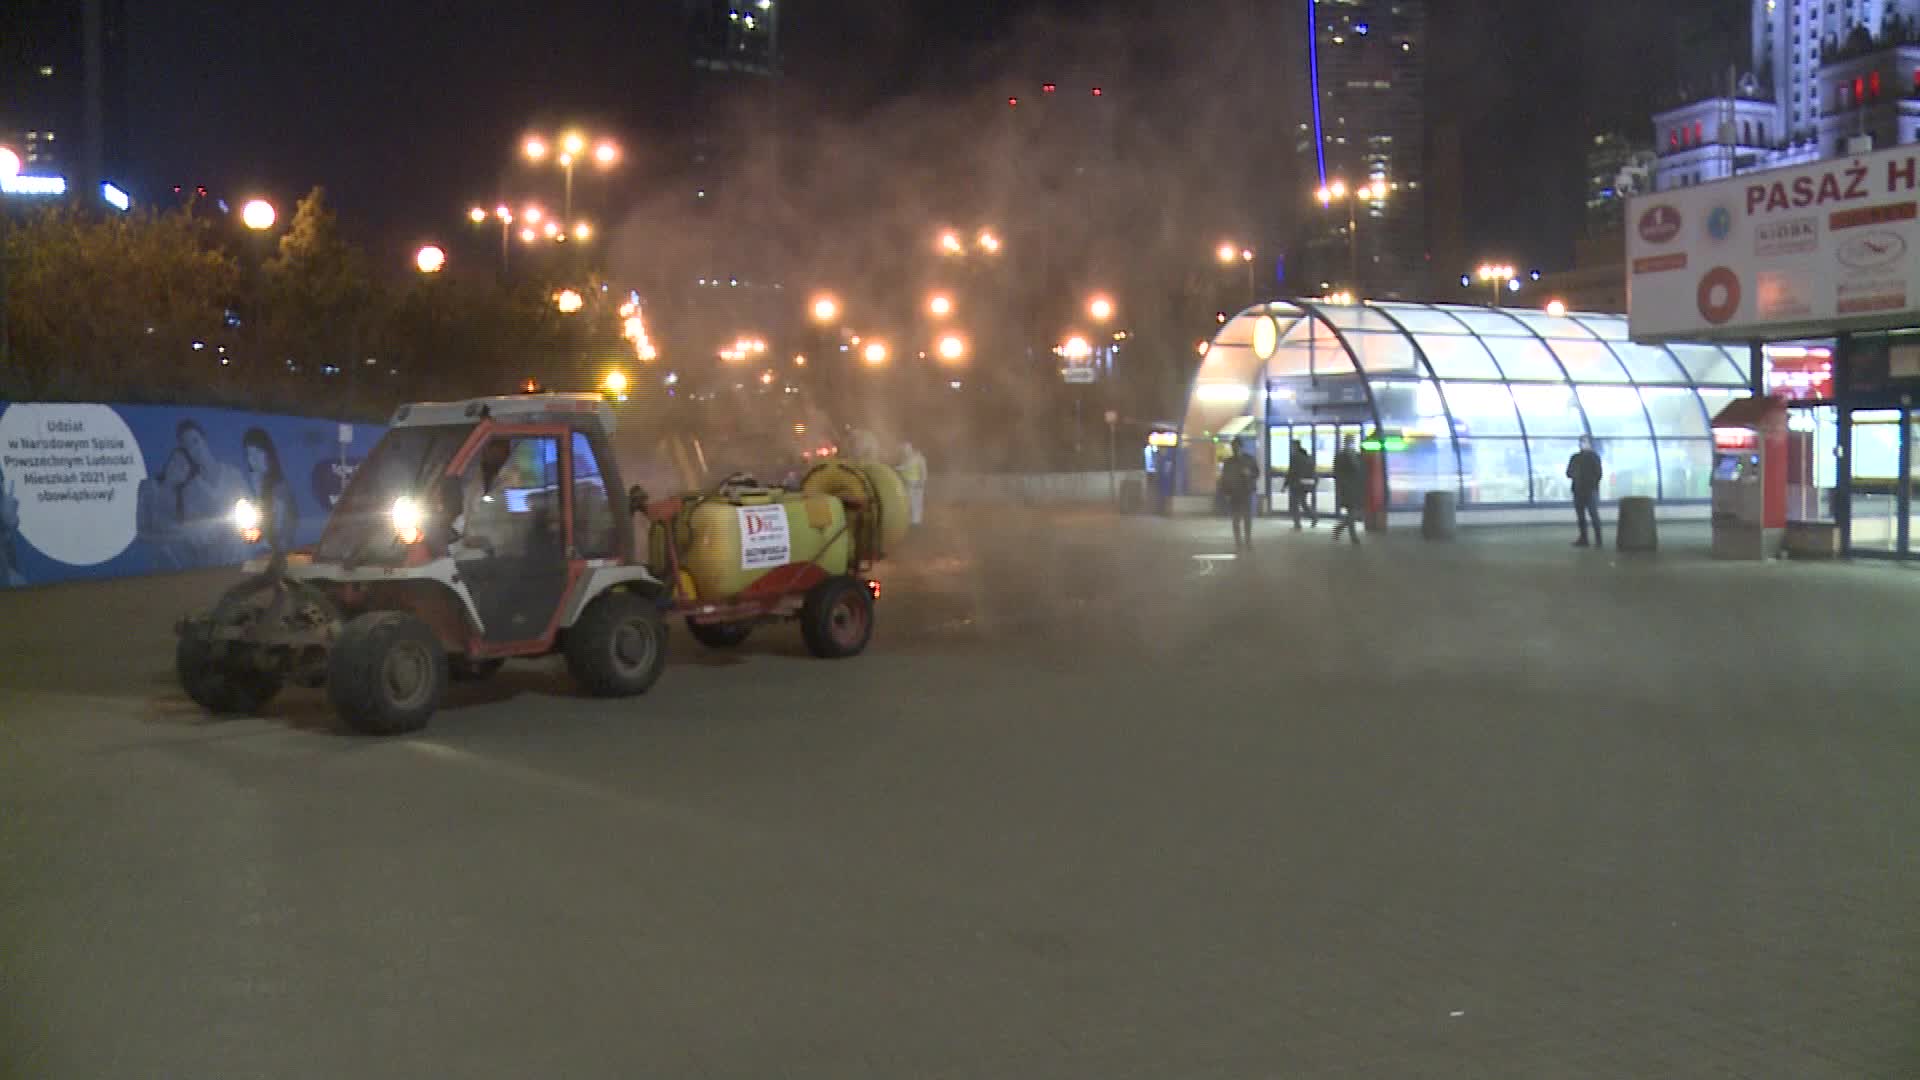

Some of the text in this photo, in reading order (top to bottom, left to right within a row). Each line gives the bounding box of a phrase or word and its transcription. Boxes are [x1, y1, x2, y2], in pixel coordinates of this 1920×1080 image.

[1746, 160, 1869, 216] PASAŻ
[8, 437, 124, 452] w Narodowym Spisie
[4, 454, 134, 468] Powszechnym Ludności
[24, 472, 128, 485] Mieszkań 2021 jest
